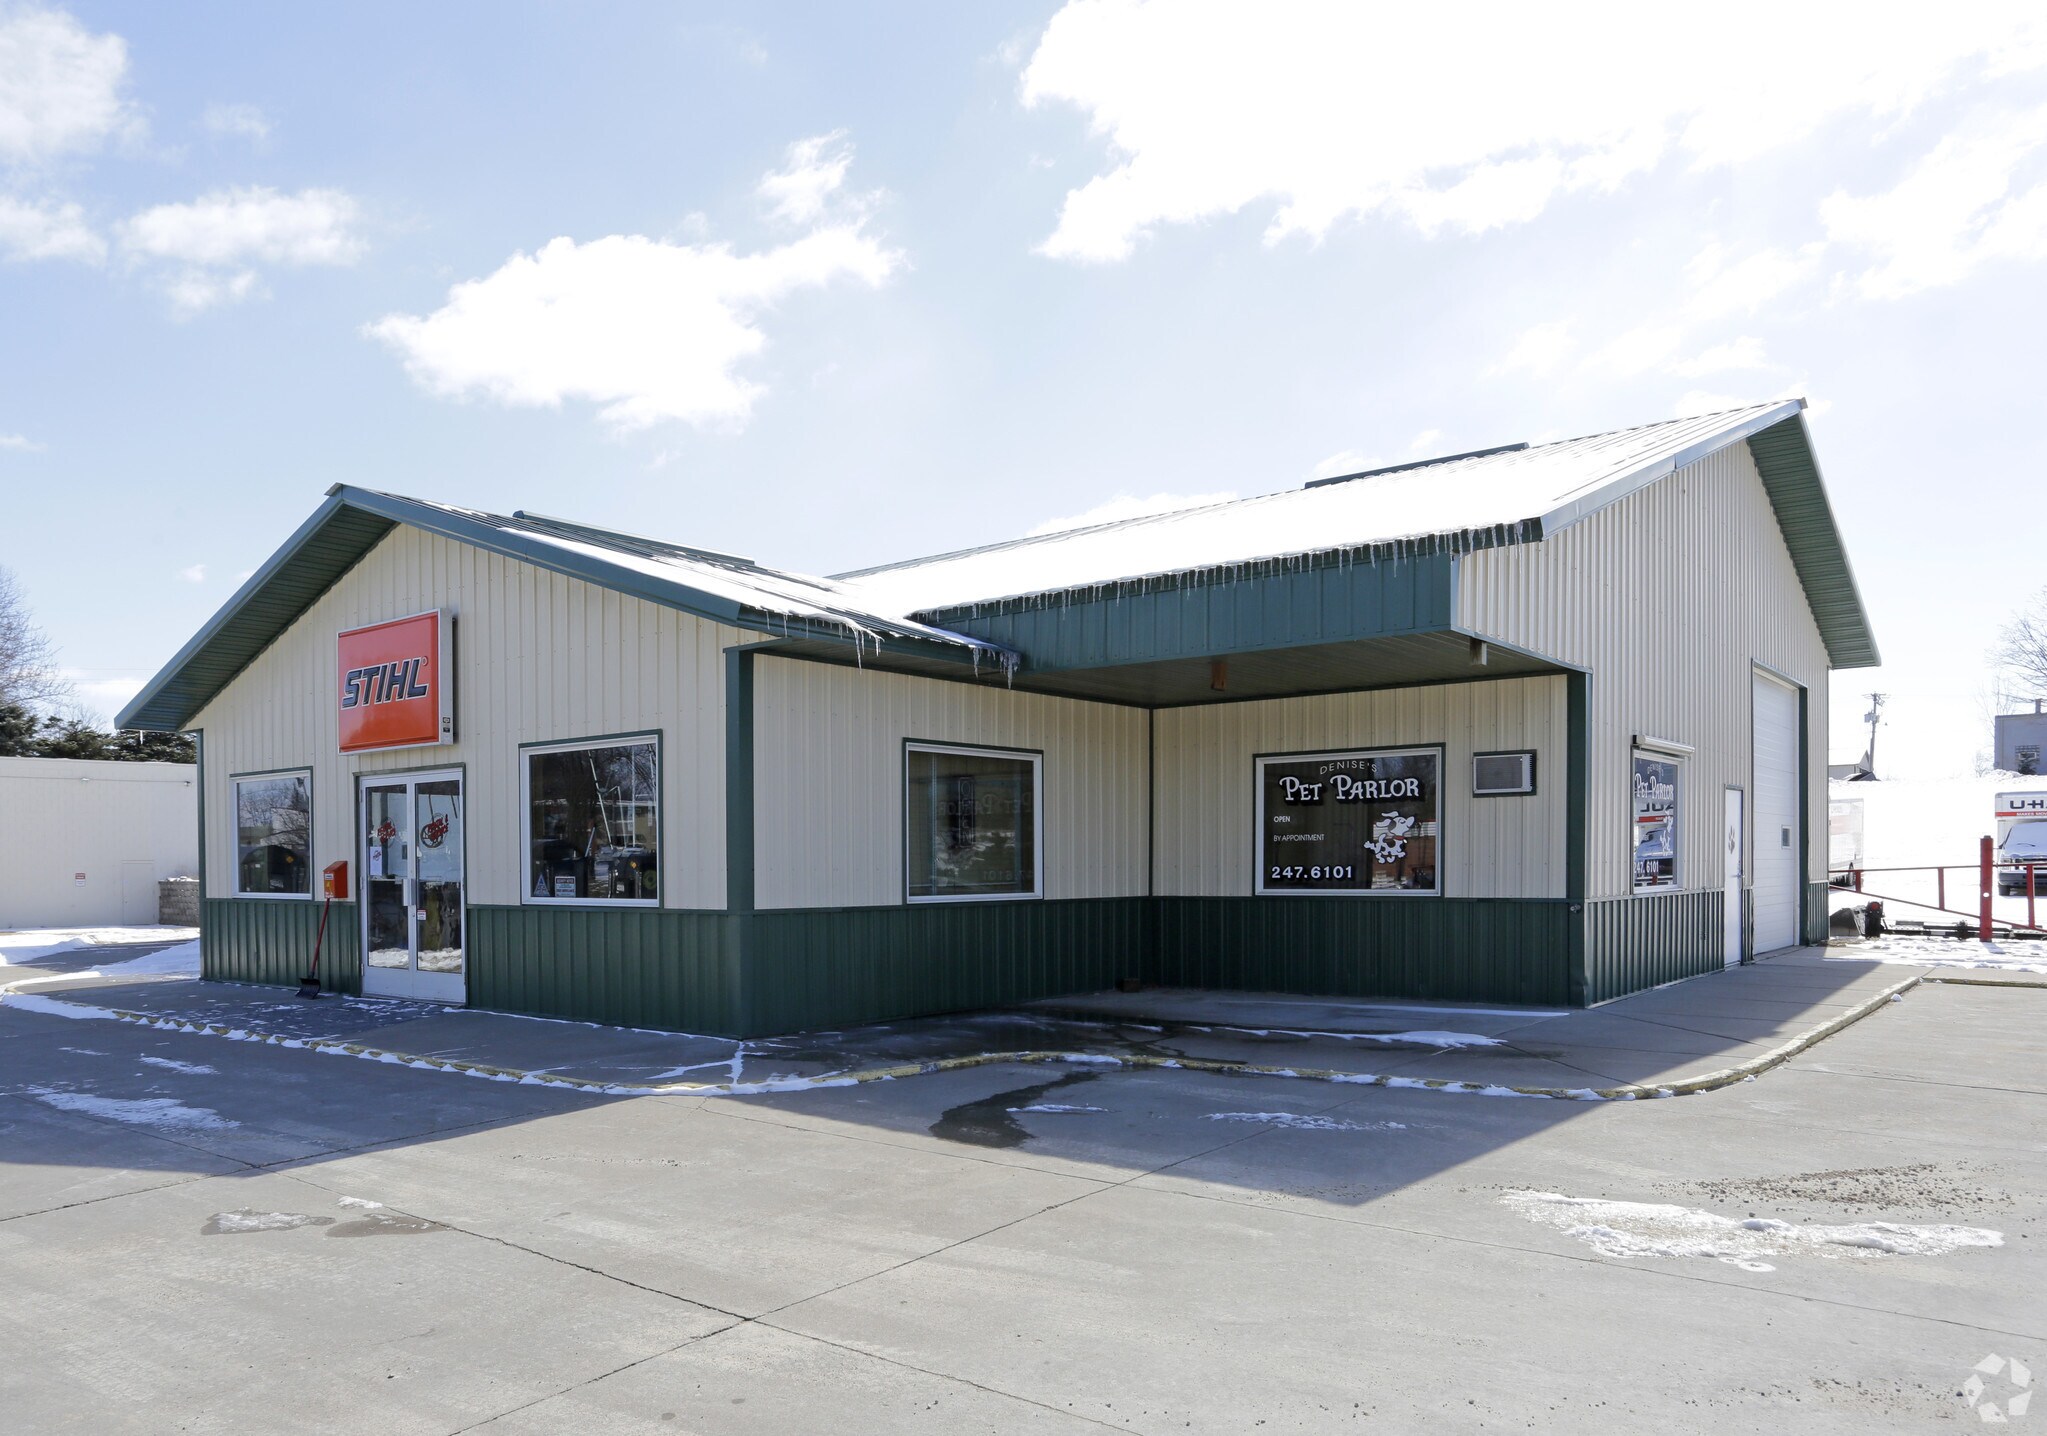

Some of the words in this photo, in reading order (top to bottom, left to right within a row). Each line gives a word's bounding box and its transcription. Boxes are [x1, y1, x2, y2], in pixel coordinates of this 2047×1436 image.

[341, 657, 429, 710] STIHL
[1320, 760, 1377, 775] DENISE'S
[1279, 776, 1322, 801] PET
[1329, 774, 1419, 800] PARLOR
[2010, 800, 2047, 809] U-H
[1271, 865, 1352, 879] 247.6101
